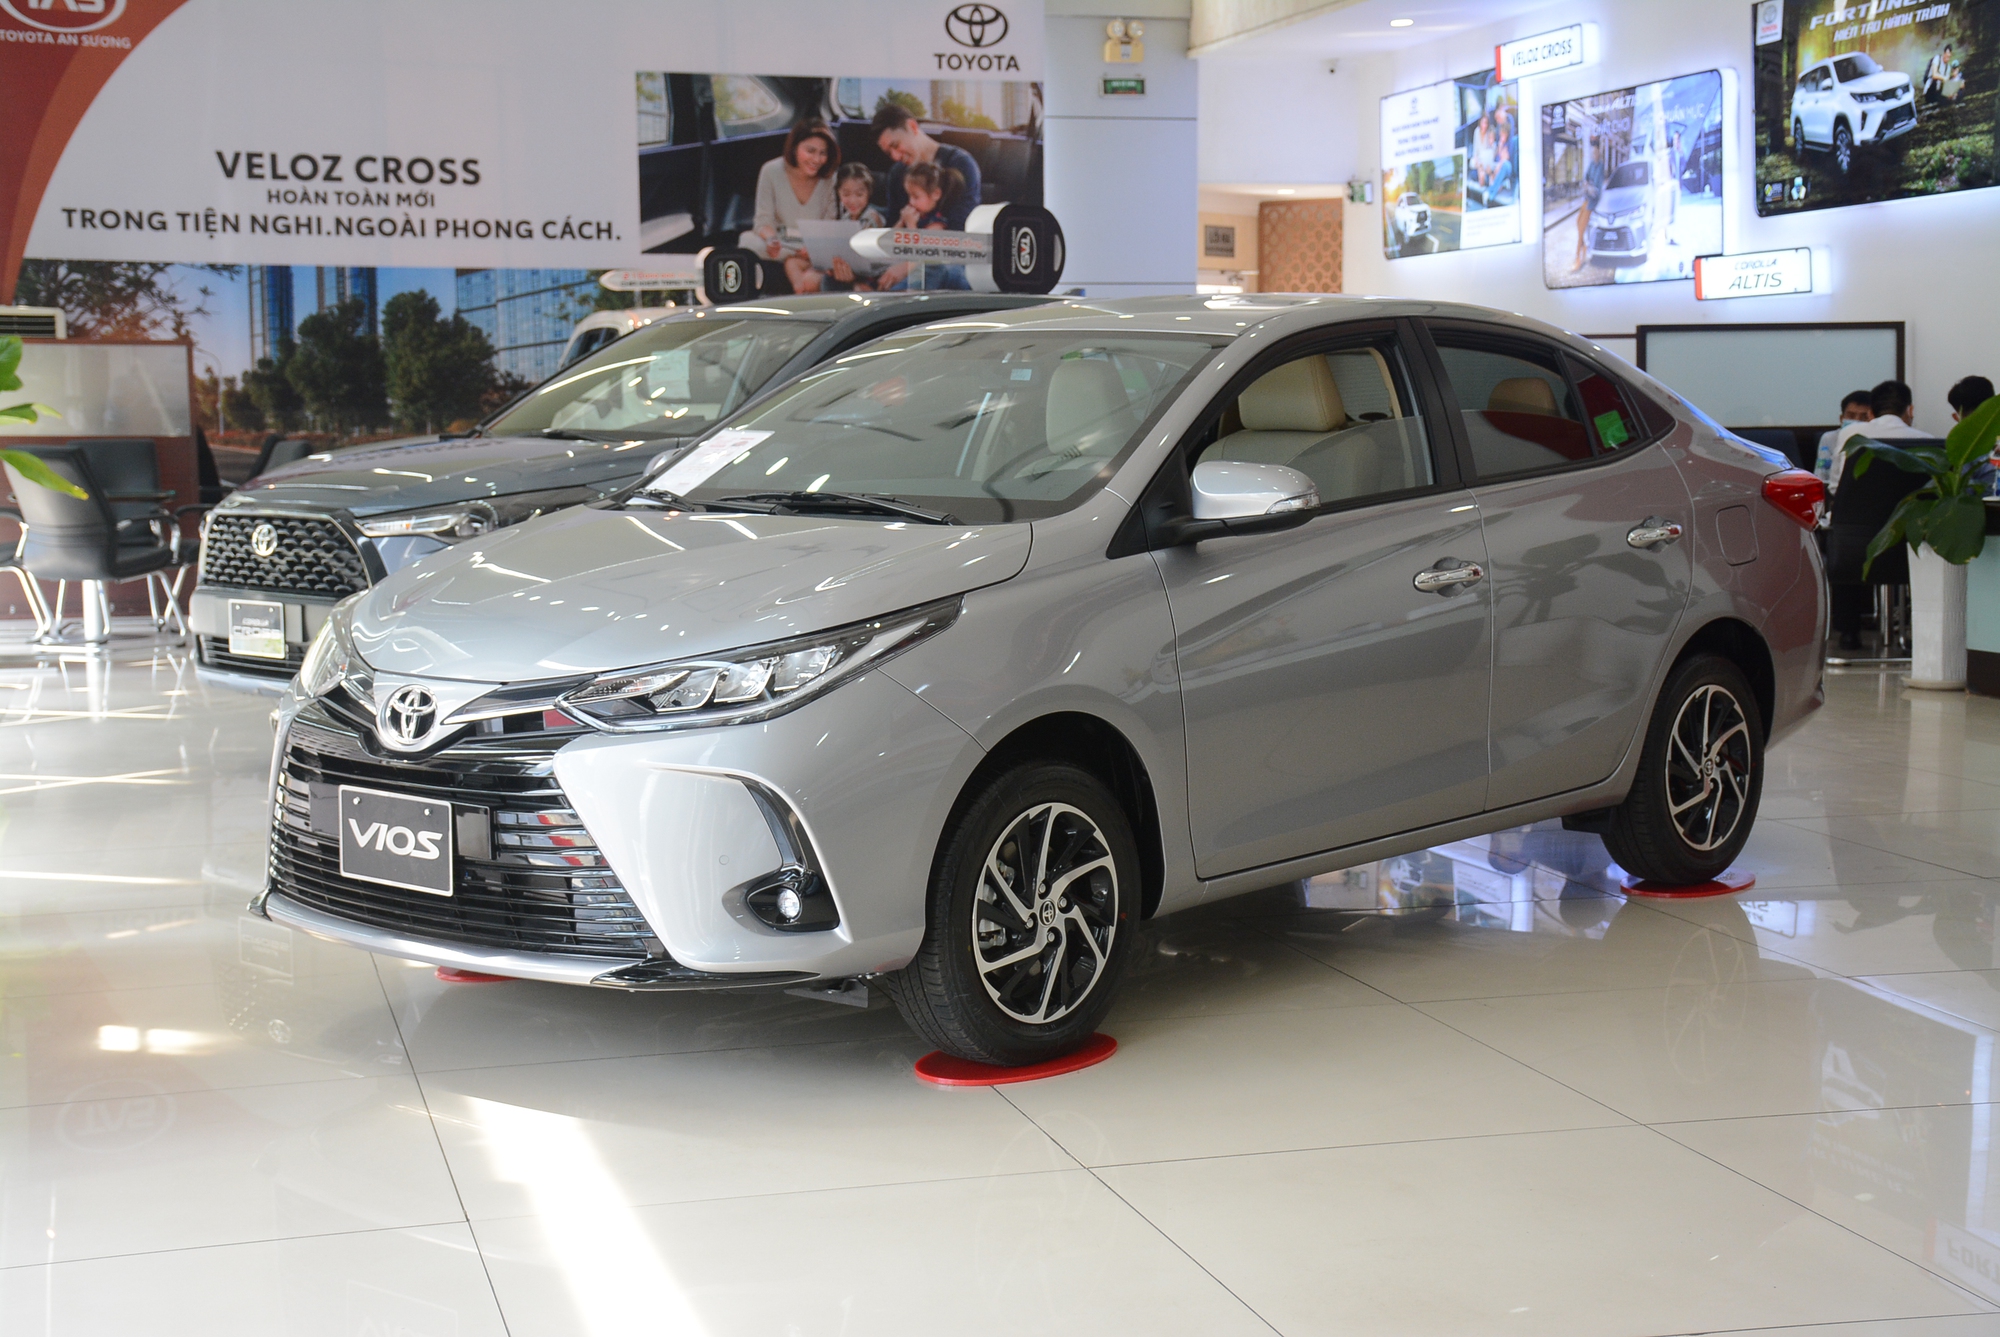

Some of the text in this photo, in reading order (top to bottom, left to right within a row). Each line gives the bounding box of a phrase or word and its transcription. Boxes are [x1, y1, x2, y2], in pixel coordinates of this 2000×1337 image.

[0, 29, 55, 44] TOYOTA
[57, 33, 79, 45] AN
[934, 54, 1020, 72] TOYOTA
[216, 150, 480, 185] VELOZ CROSS
[267, 186, 435, 208] HOÀN TOÀN MỚI
[62, 208, 168, 231] TRONG
[176, 207, 240, 239] TIỆN
[435, 218, 534, 239] PHONG
[542, 215, 622, 240] CÁCH.
[894, 232, 920, 244] 259
[1729, 272, 1783, 290] ALTIS
[348, 818, 443, 860] VIOS
